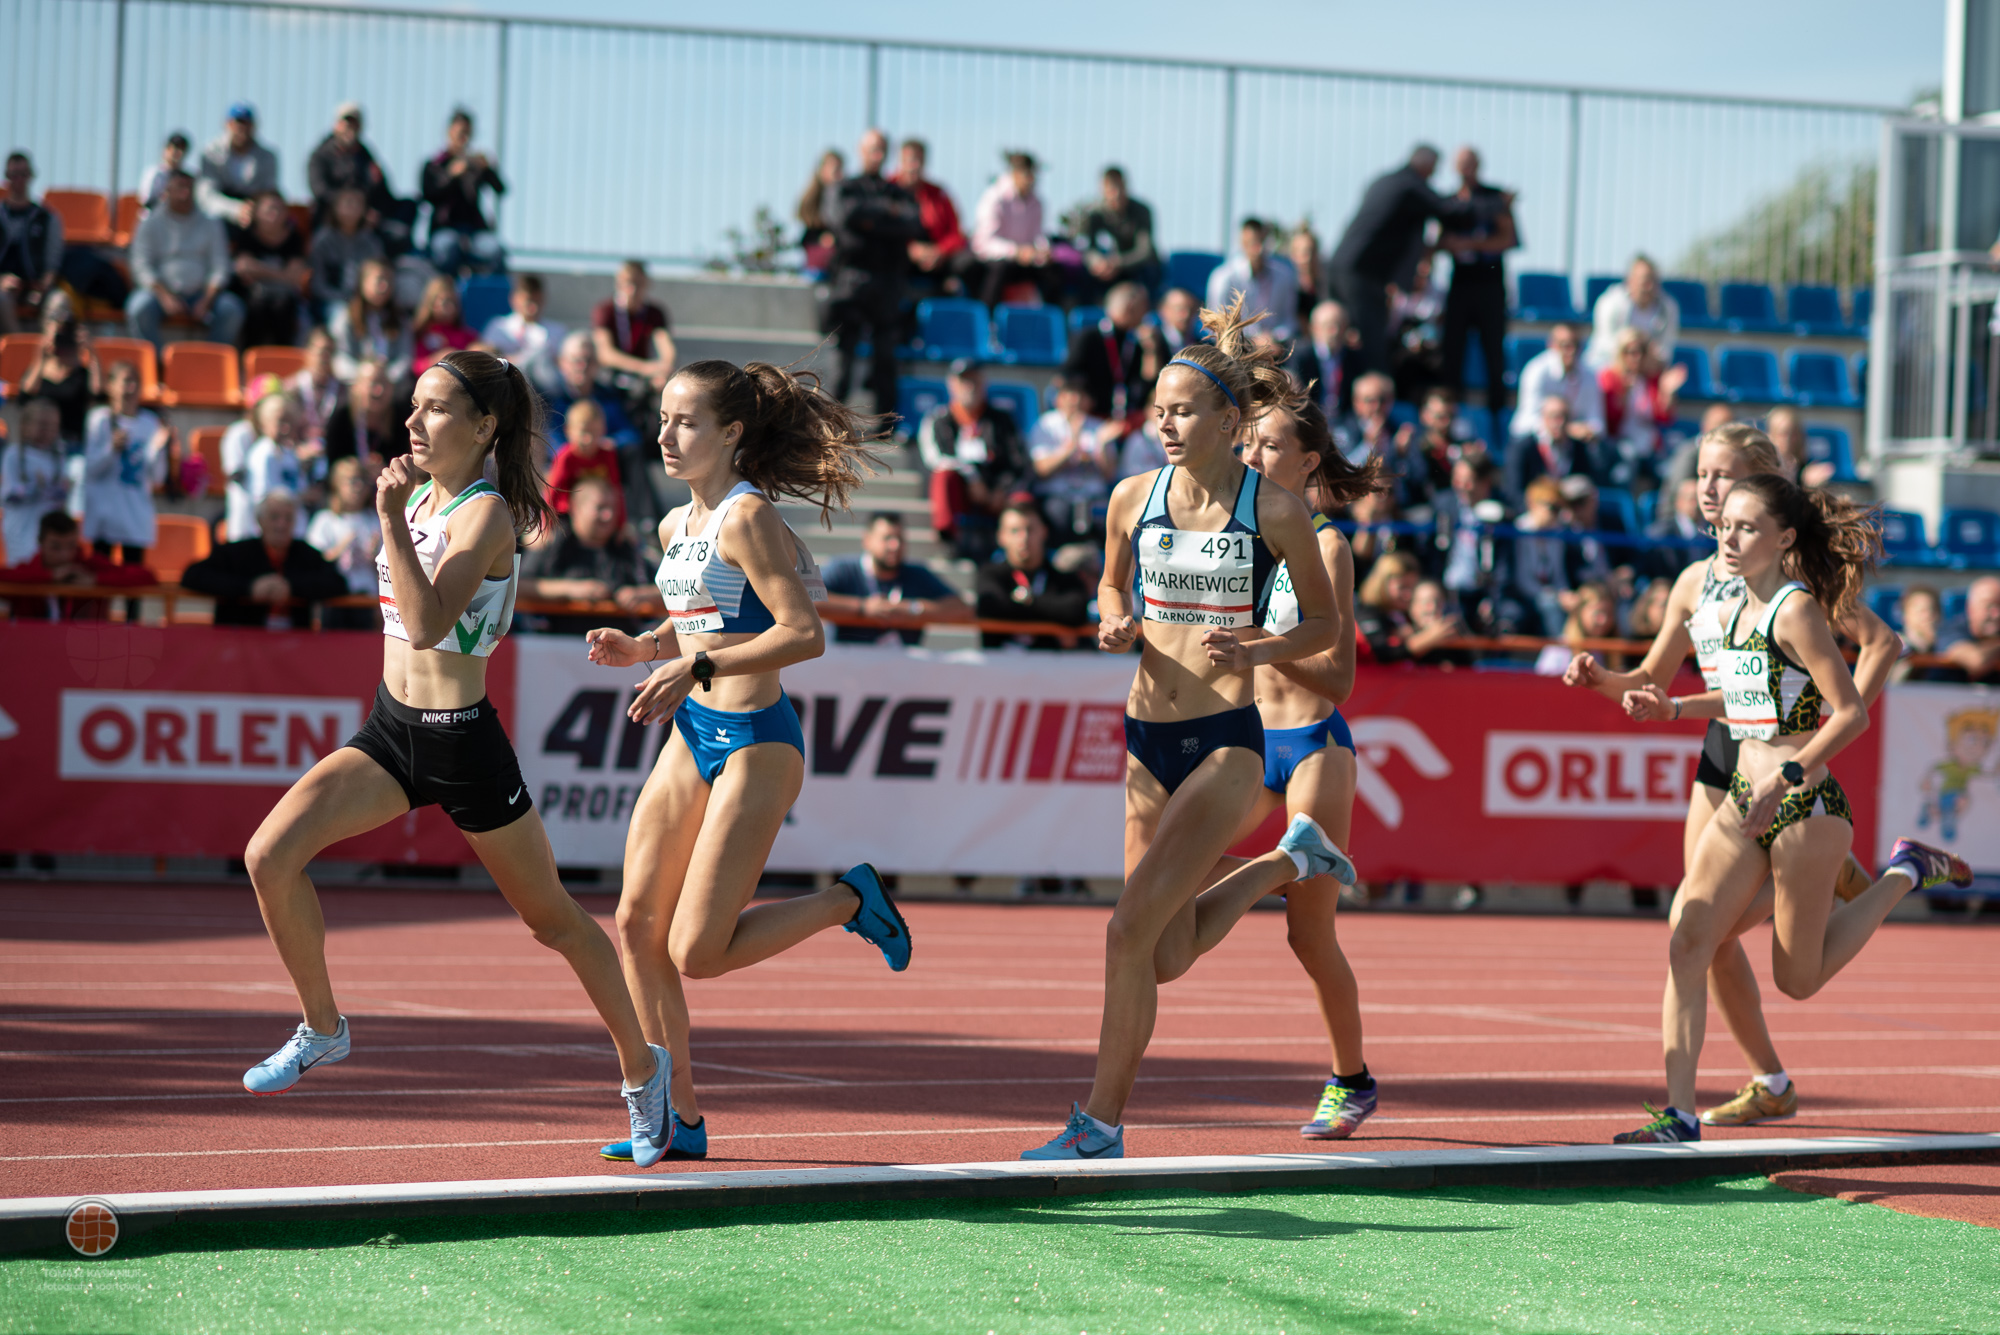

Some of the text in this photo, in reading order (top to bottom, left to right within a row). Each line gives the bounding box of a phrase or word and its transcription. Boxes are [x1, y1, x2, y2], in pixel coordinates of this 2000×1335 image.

[667, 541, 709, 562] 4F 178
[1200, 537, 1247, 560] 491
[1144, 568, 1249, 593] MARKIEWICZ
[1275, 573, 1293, 593] 60
[687, 618, 707, 631] 2019
[1158, 610, 1235, 626] TARNÓW 2019
[1735, 656, 1763, 675] 260
[1725, 690, 1772, 706] WALSKA
[421, 707, 479, 723] NIKE PRO
[79, 704, 339, 768] ORLEN
